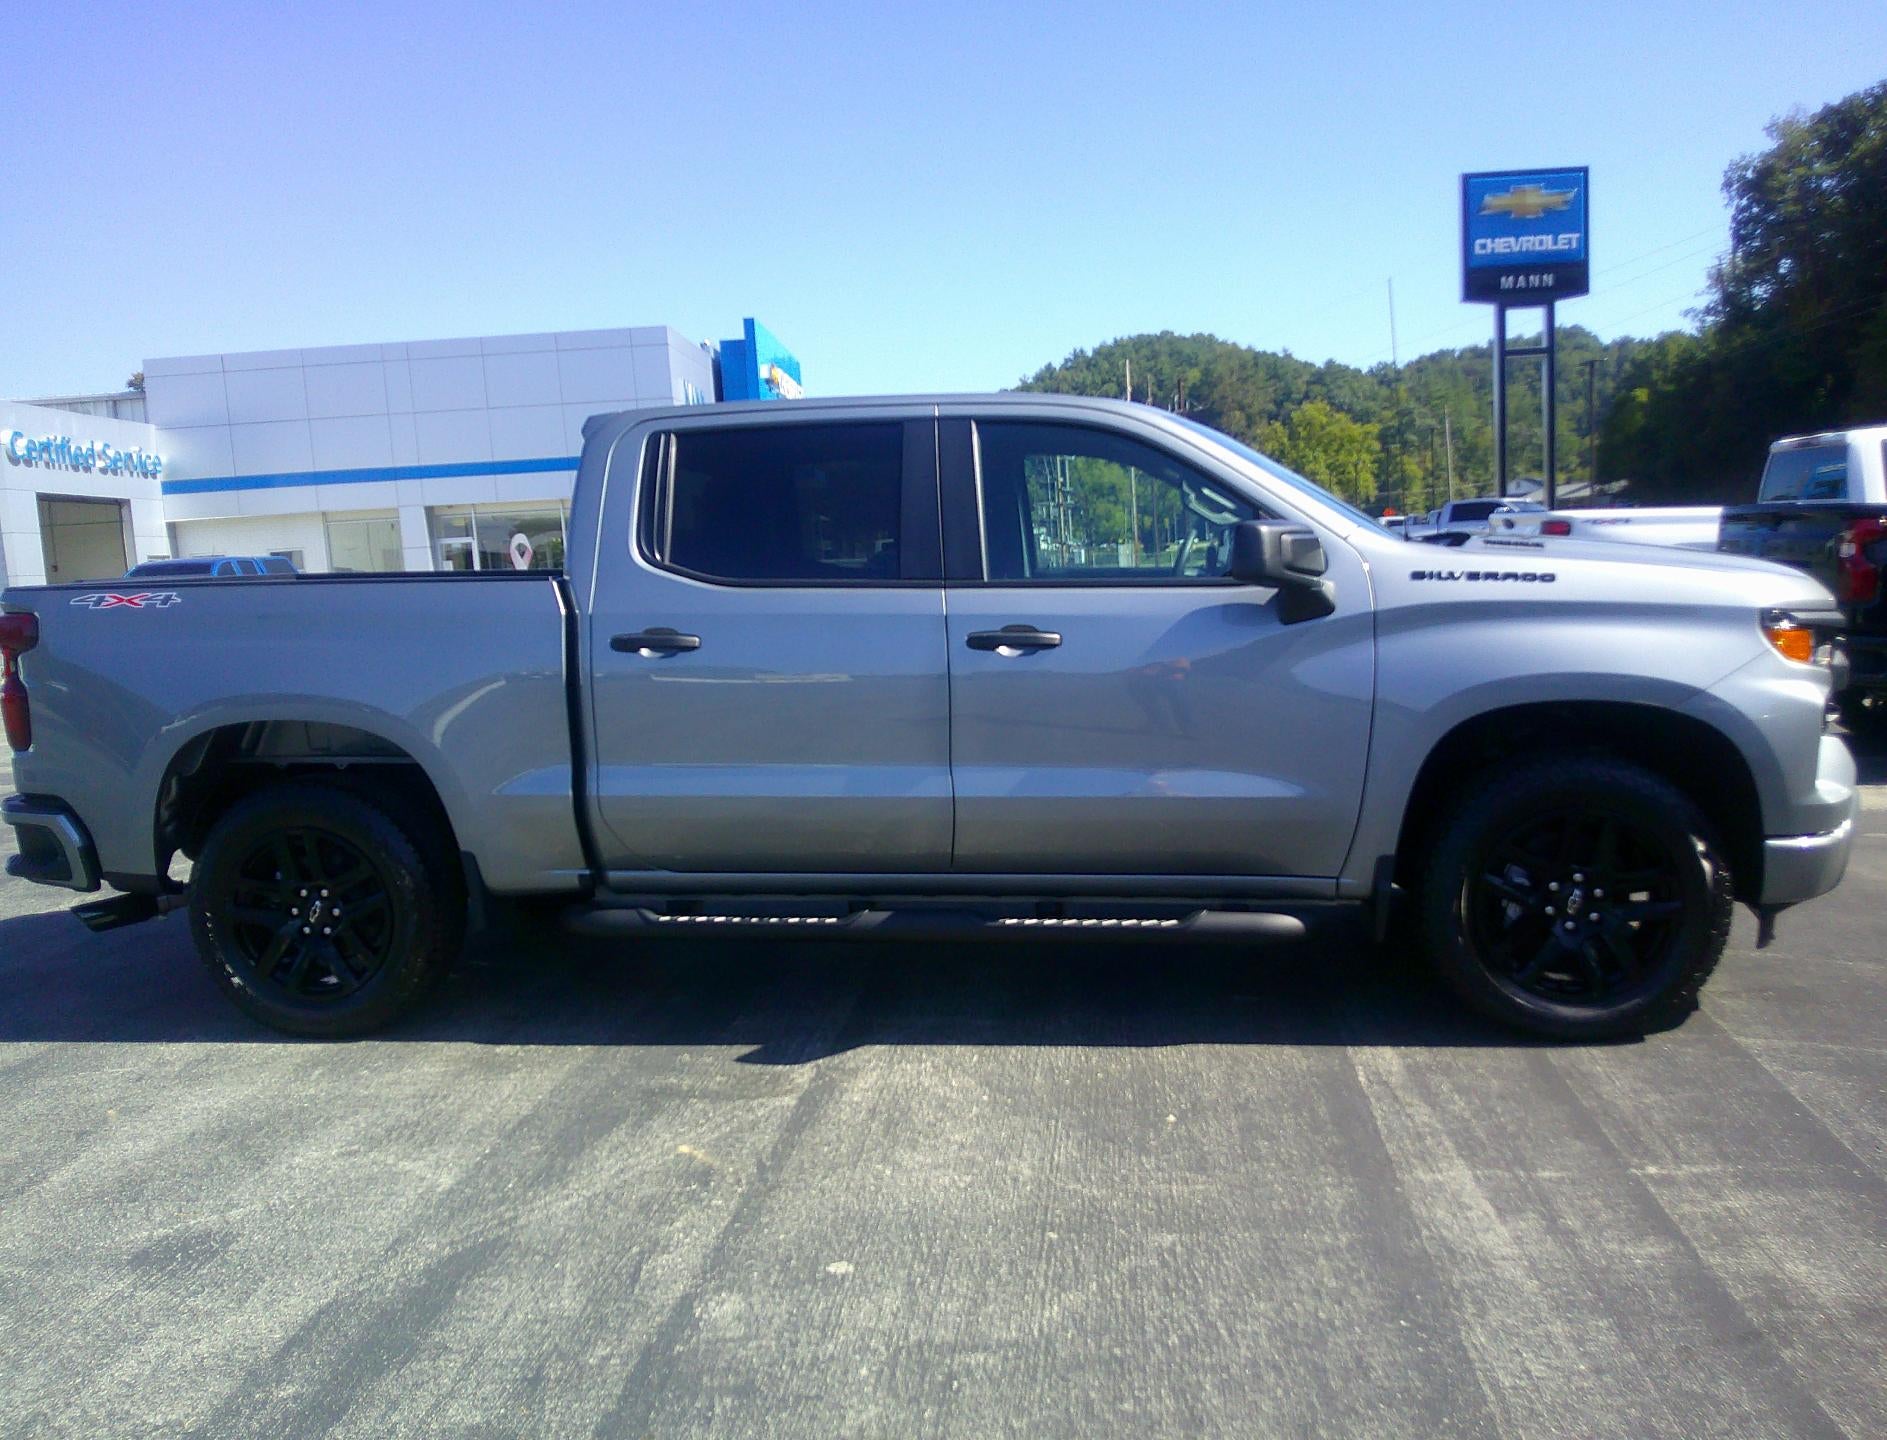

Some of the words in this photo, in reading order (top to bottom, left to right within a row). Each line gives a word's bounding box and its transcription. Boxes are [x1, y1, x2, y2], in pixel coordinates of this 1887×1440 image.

[1474, 233, 1580, 255] CHEVROLET
[1500, 273, 1554, 290] MANN
[10, 431, 96, 468] Certified
[101, 442, 162, 475] Service
[1410, 570, 1556, 583] SILVERADO
